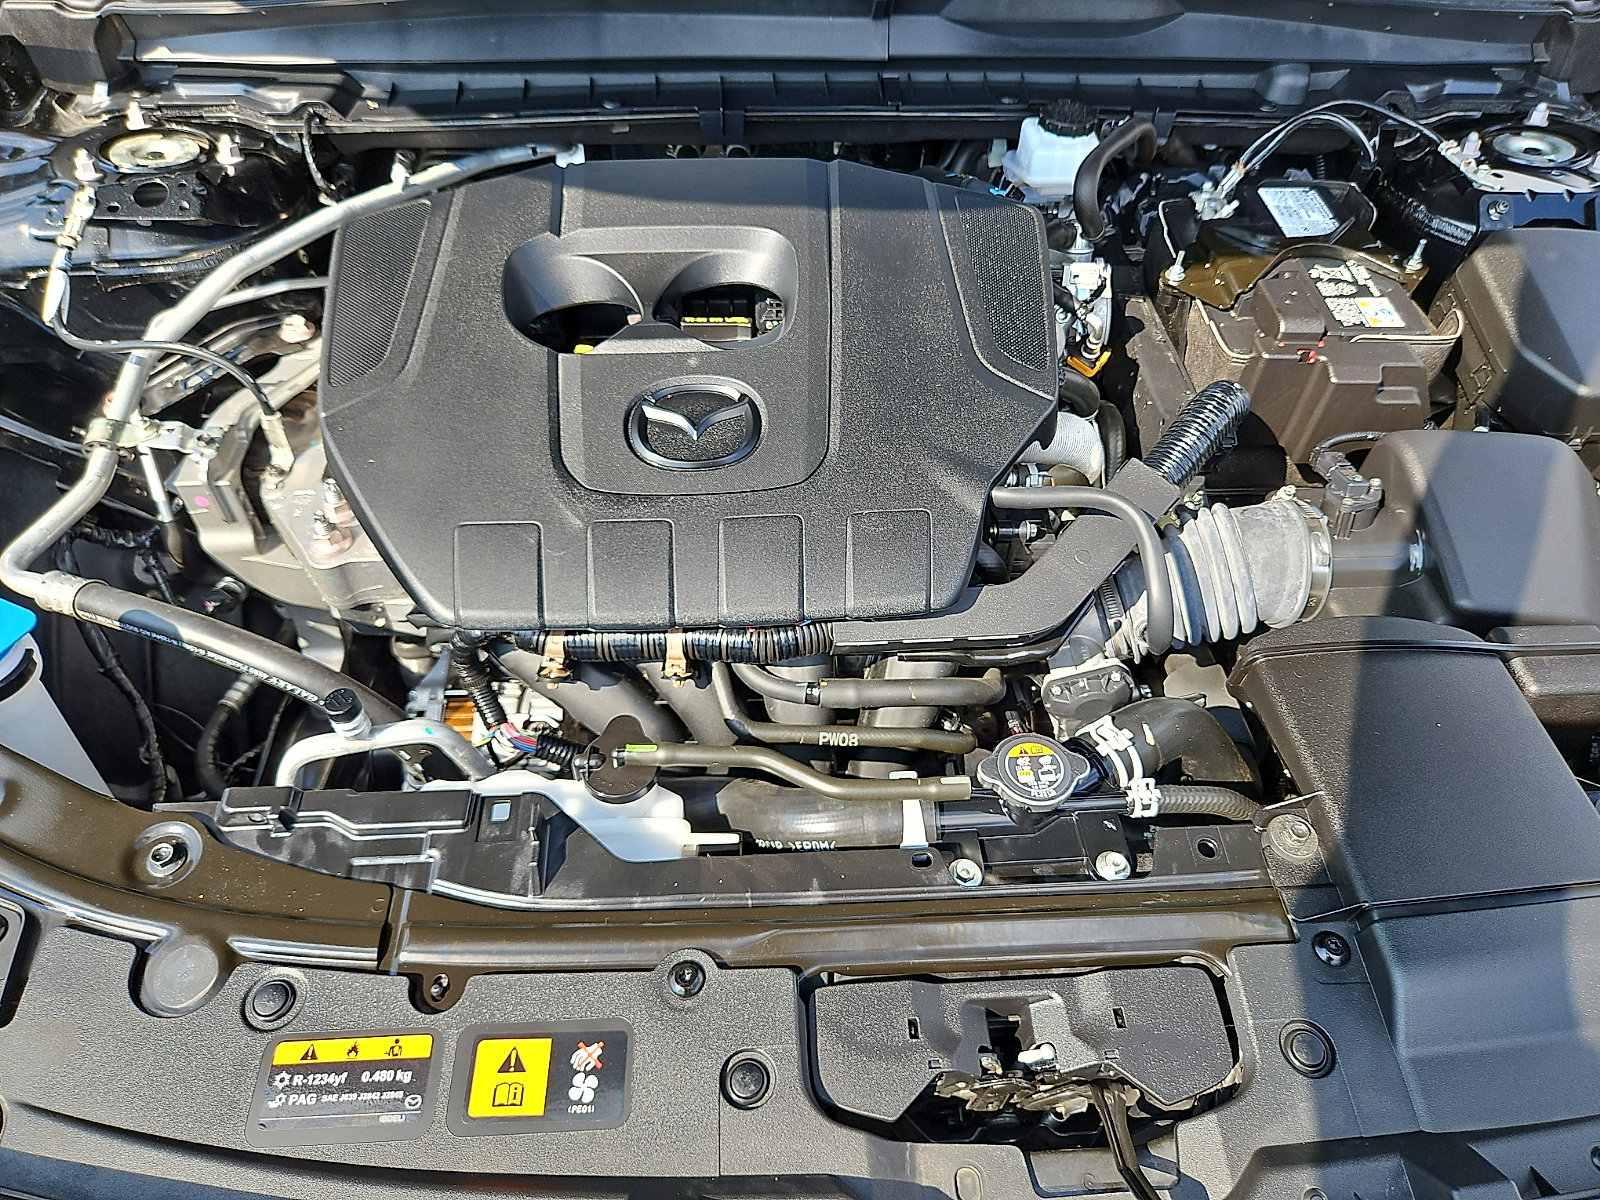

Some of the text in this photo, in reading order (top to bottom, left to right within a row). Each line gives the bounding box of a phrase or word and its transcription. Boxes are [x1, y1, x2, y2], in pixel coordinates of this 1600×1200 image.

[292, 1068, 413, 1087] R-1234yf 0.480 kg
[288, 1093, 318, 1106] PAG
[321, 1094, 339, 1102] SAE
